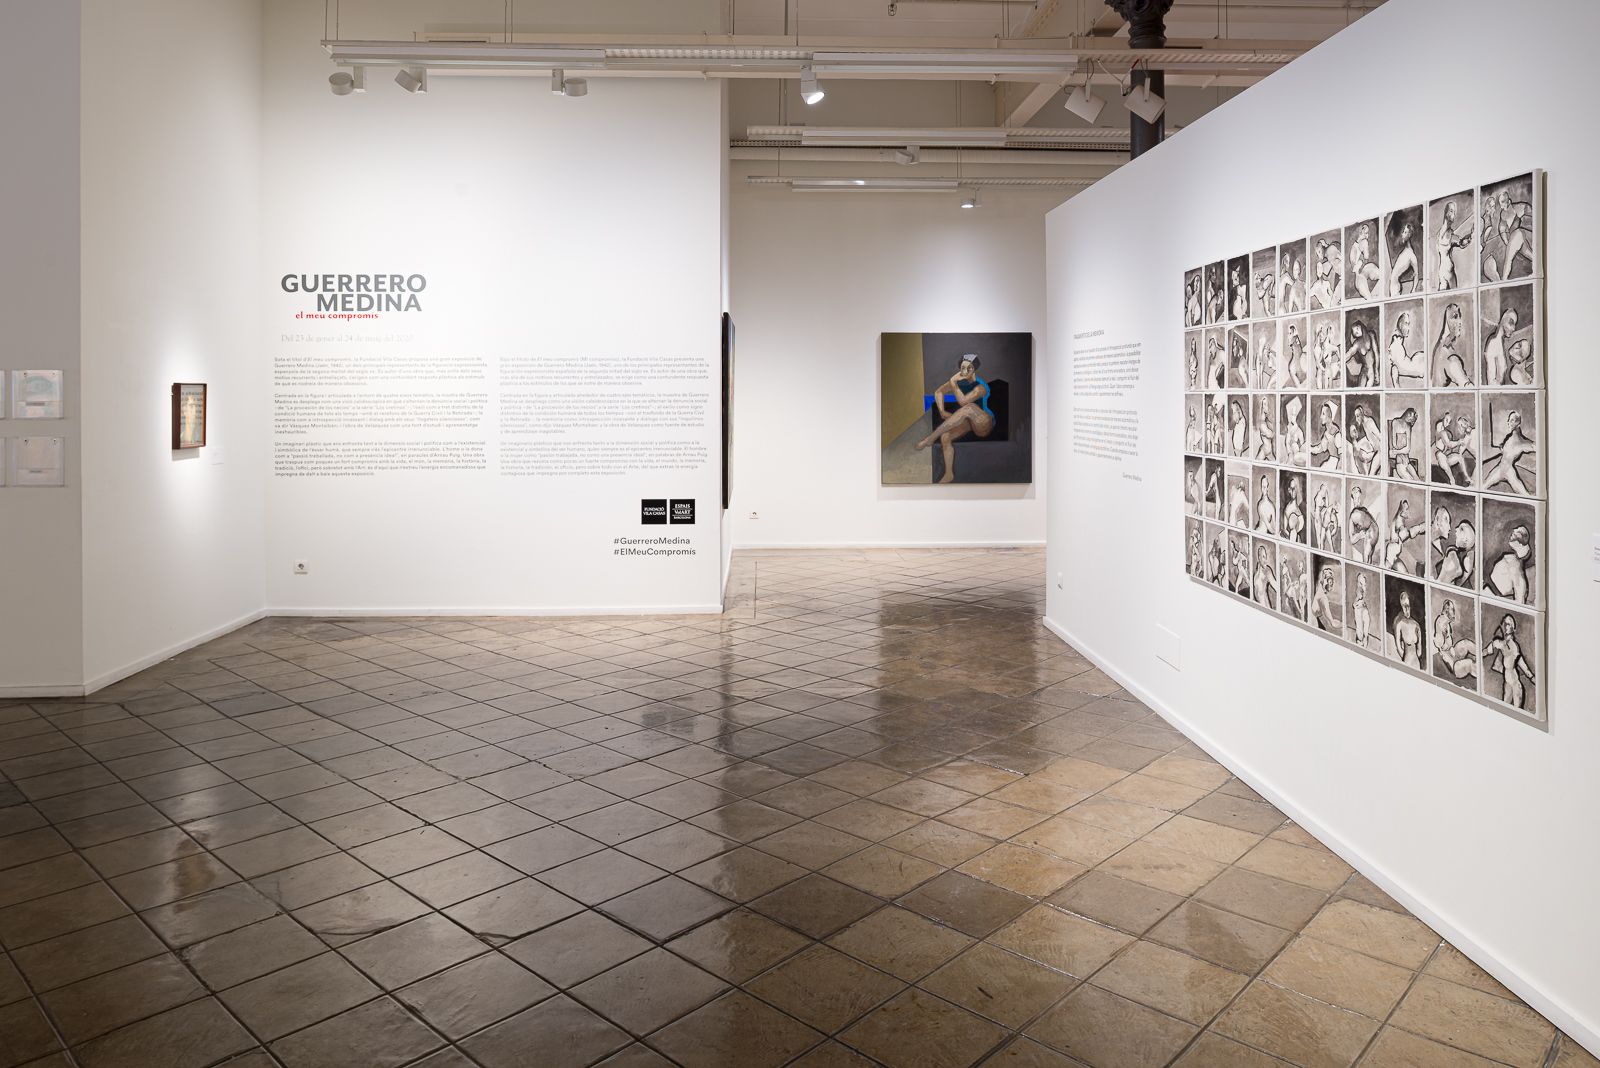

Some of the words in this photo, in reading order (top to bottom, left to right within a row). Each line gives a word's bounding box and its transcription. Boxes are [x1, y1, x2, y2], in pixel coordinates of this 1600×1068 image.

[281, 274, 426, 292] GUERRERO
[317, 294, 422, 312] MEDINA
[295, 311, 303, 319] el
